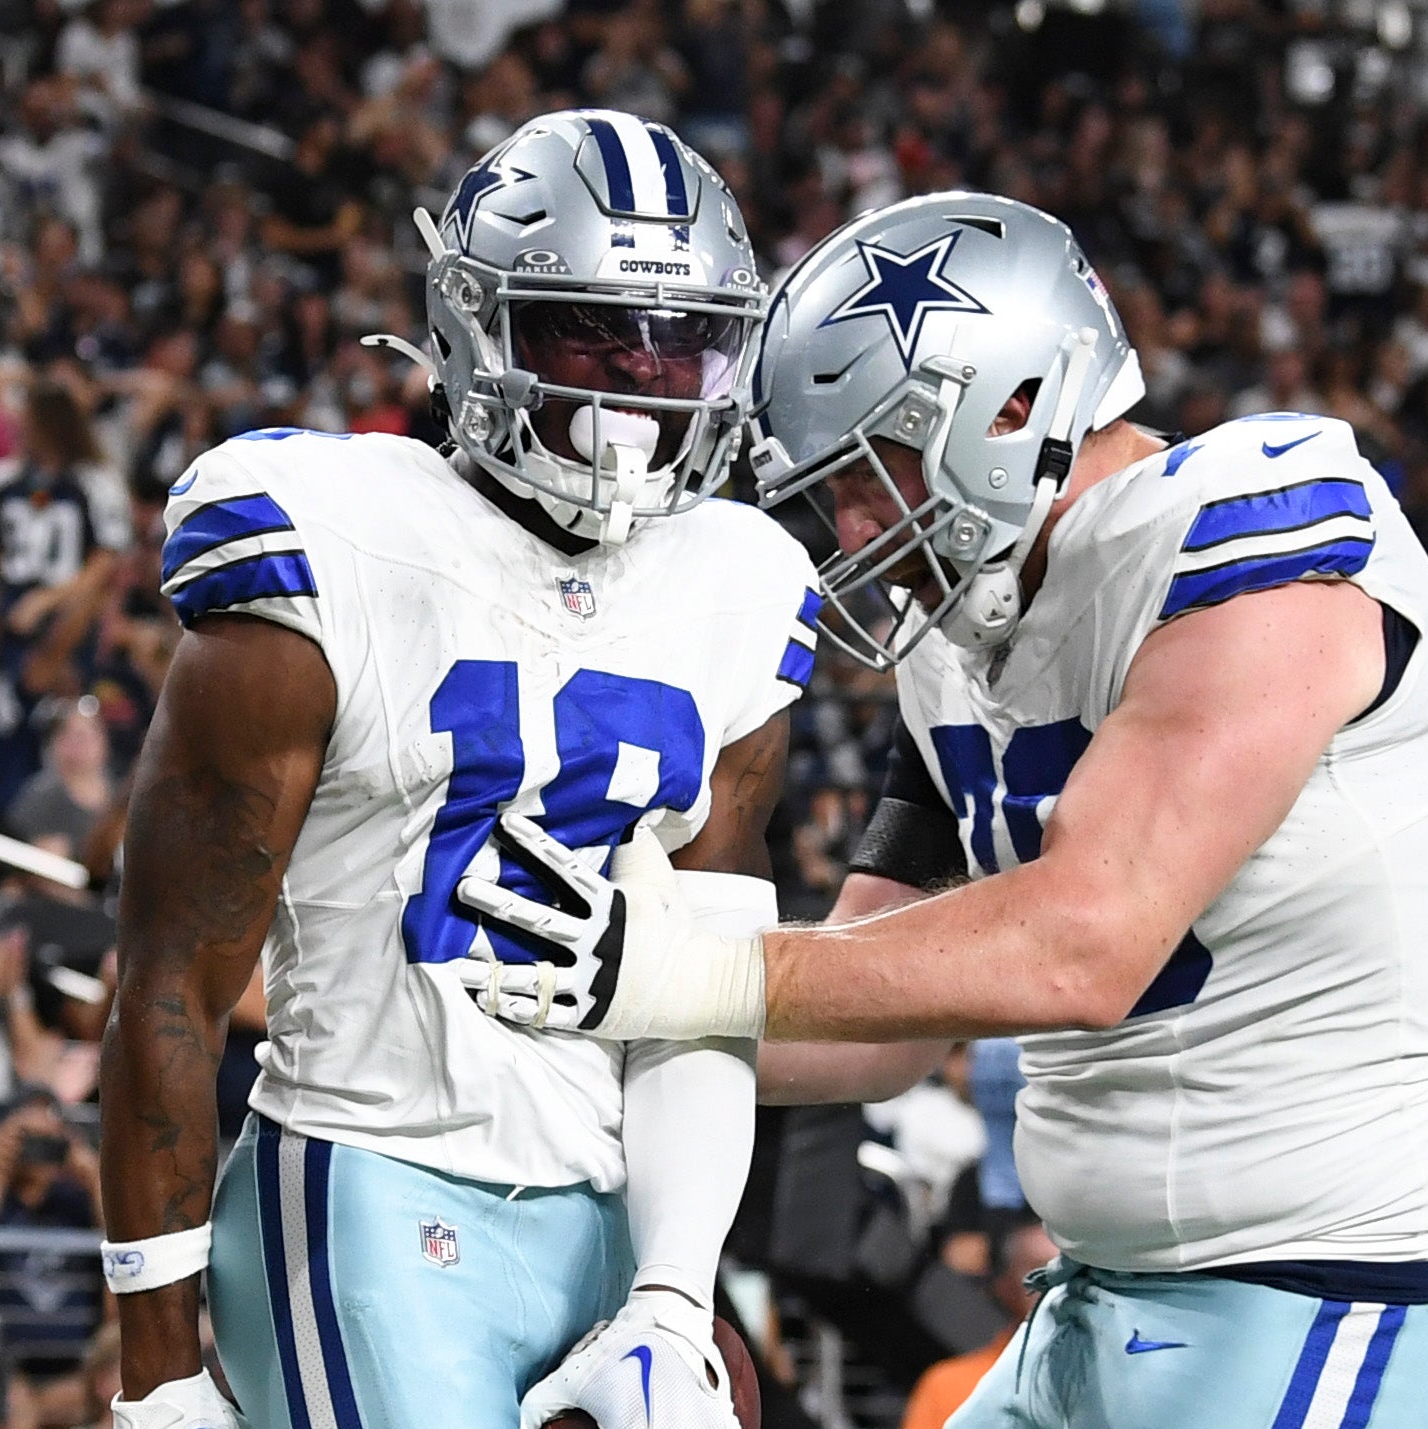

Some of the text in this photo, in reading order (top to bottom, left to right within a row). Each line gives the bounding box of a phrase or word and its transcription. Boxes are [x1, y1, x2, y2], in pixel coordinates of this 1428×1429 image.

[516, 264, 567, 275] OAKLEY
[619, 259, 691, 276] COWBOYS
[566, 593, 592, 613] NFL
[429, 1238, 456, 1260] NFL
